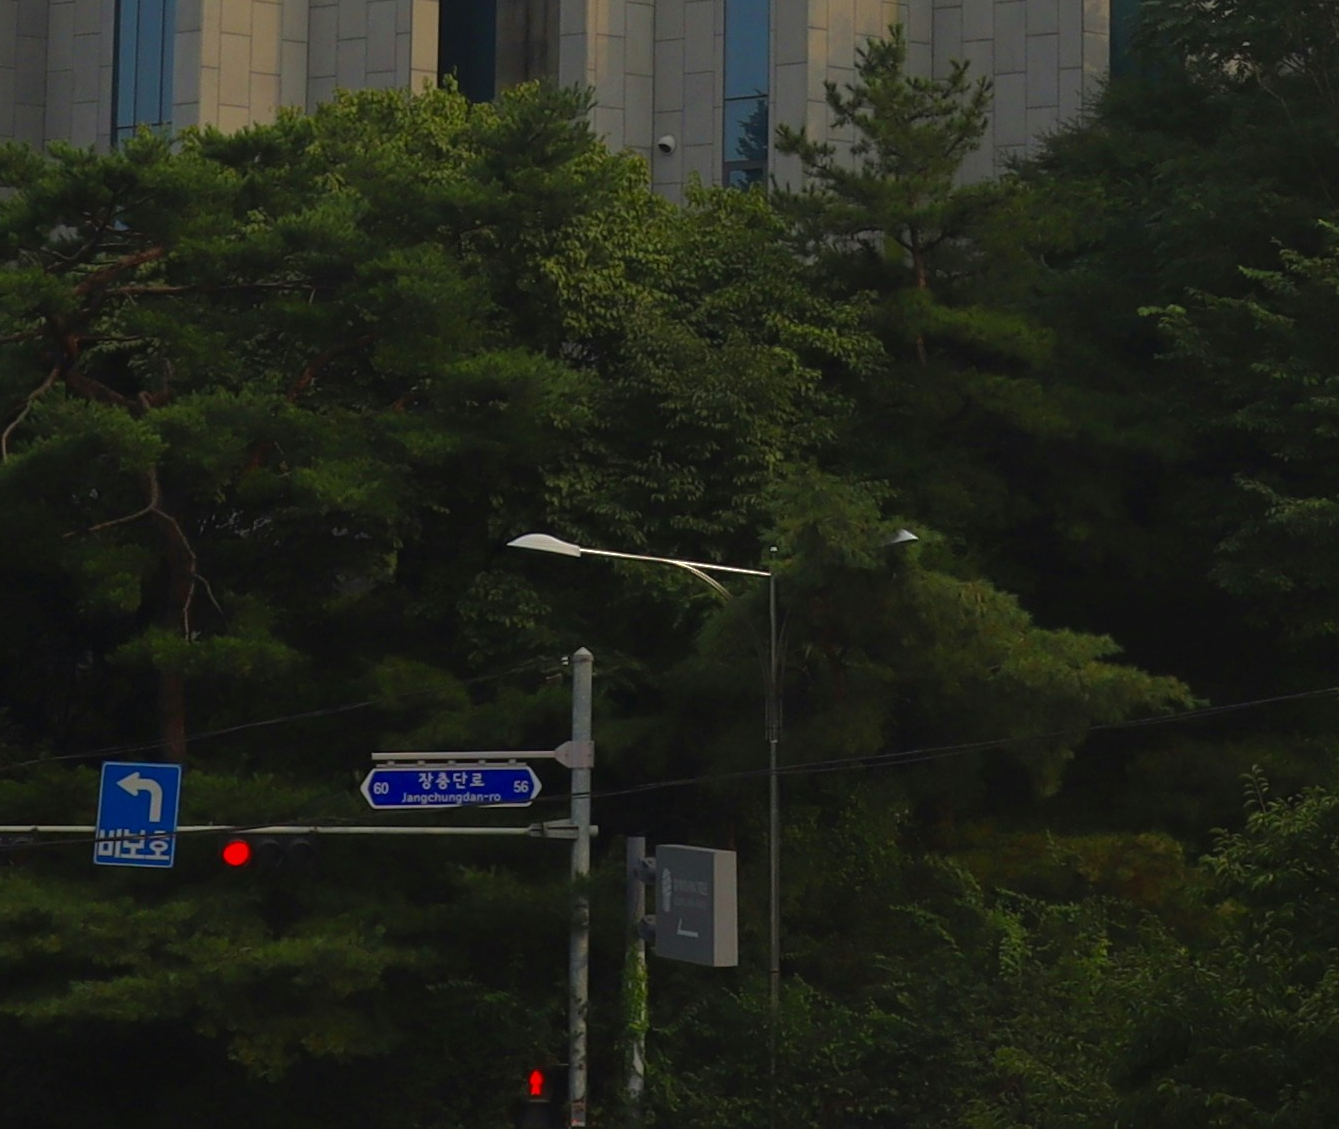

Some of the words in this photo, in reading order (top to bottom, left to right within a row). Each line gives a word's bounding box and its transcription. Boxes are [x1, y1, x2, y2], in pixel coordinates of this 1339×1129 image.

[418, 772, 485, 790] 장충단로
[513, 780, 529, 793] 56
[373, 782, 390, 795] 60
[401, 792, 502, 804] Jangchungdan-ro
[97, 828, 170, 861] 비보호
